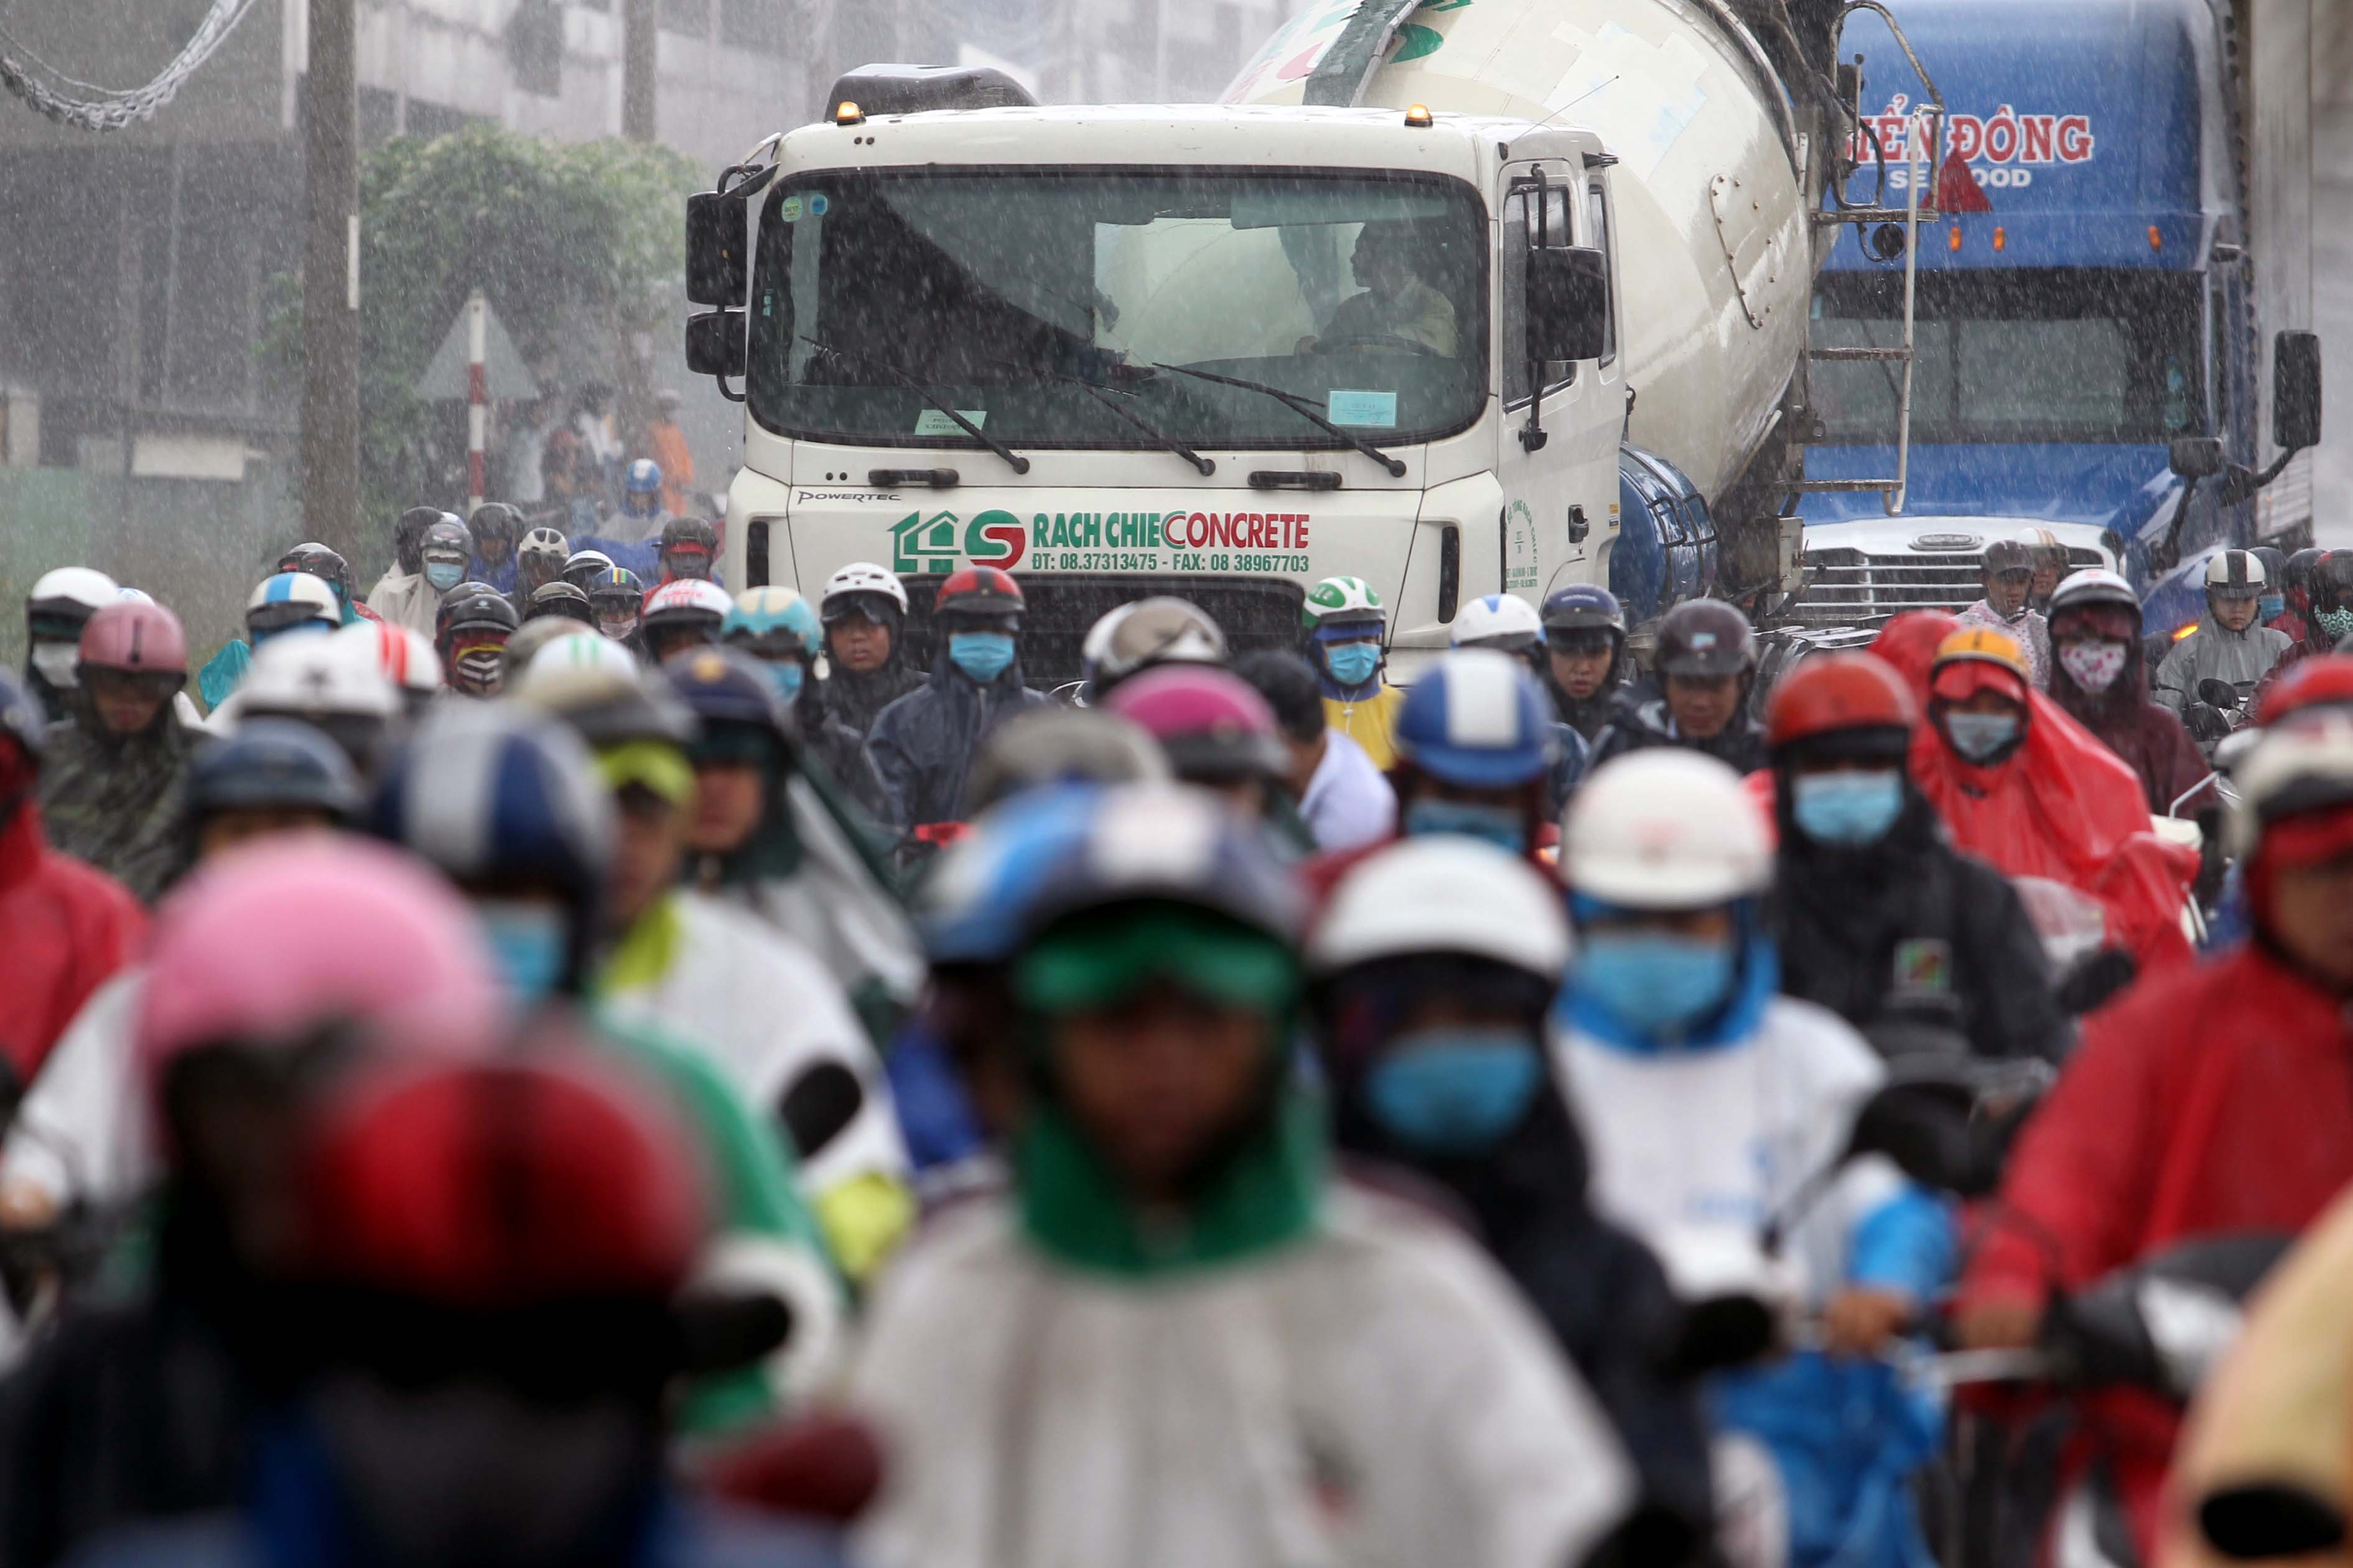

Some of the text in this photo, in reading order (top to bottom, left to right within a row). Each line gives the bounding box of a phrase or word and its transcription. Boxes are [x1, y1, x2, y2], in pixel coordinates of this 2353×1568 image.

[1947, 104, 2094, 163] ĐÔNG
[1889, 169, 2031, 188] SEOOD
[798, 491, 902, 505] POWERTEC
[1033, 513, 1101, 548] RACH
[1165, 513, 1310, 549] CONCRETE
[1032, 552, 1055, 570] ĐT:
[1060, 553, 1157, 570] 08.37313475
[1173, 554, 1206, 570] FAX:
[1211, 554, 1229, 571] 08
[1234, 554, 1309, 572] 38967703
